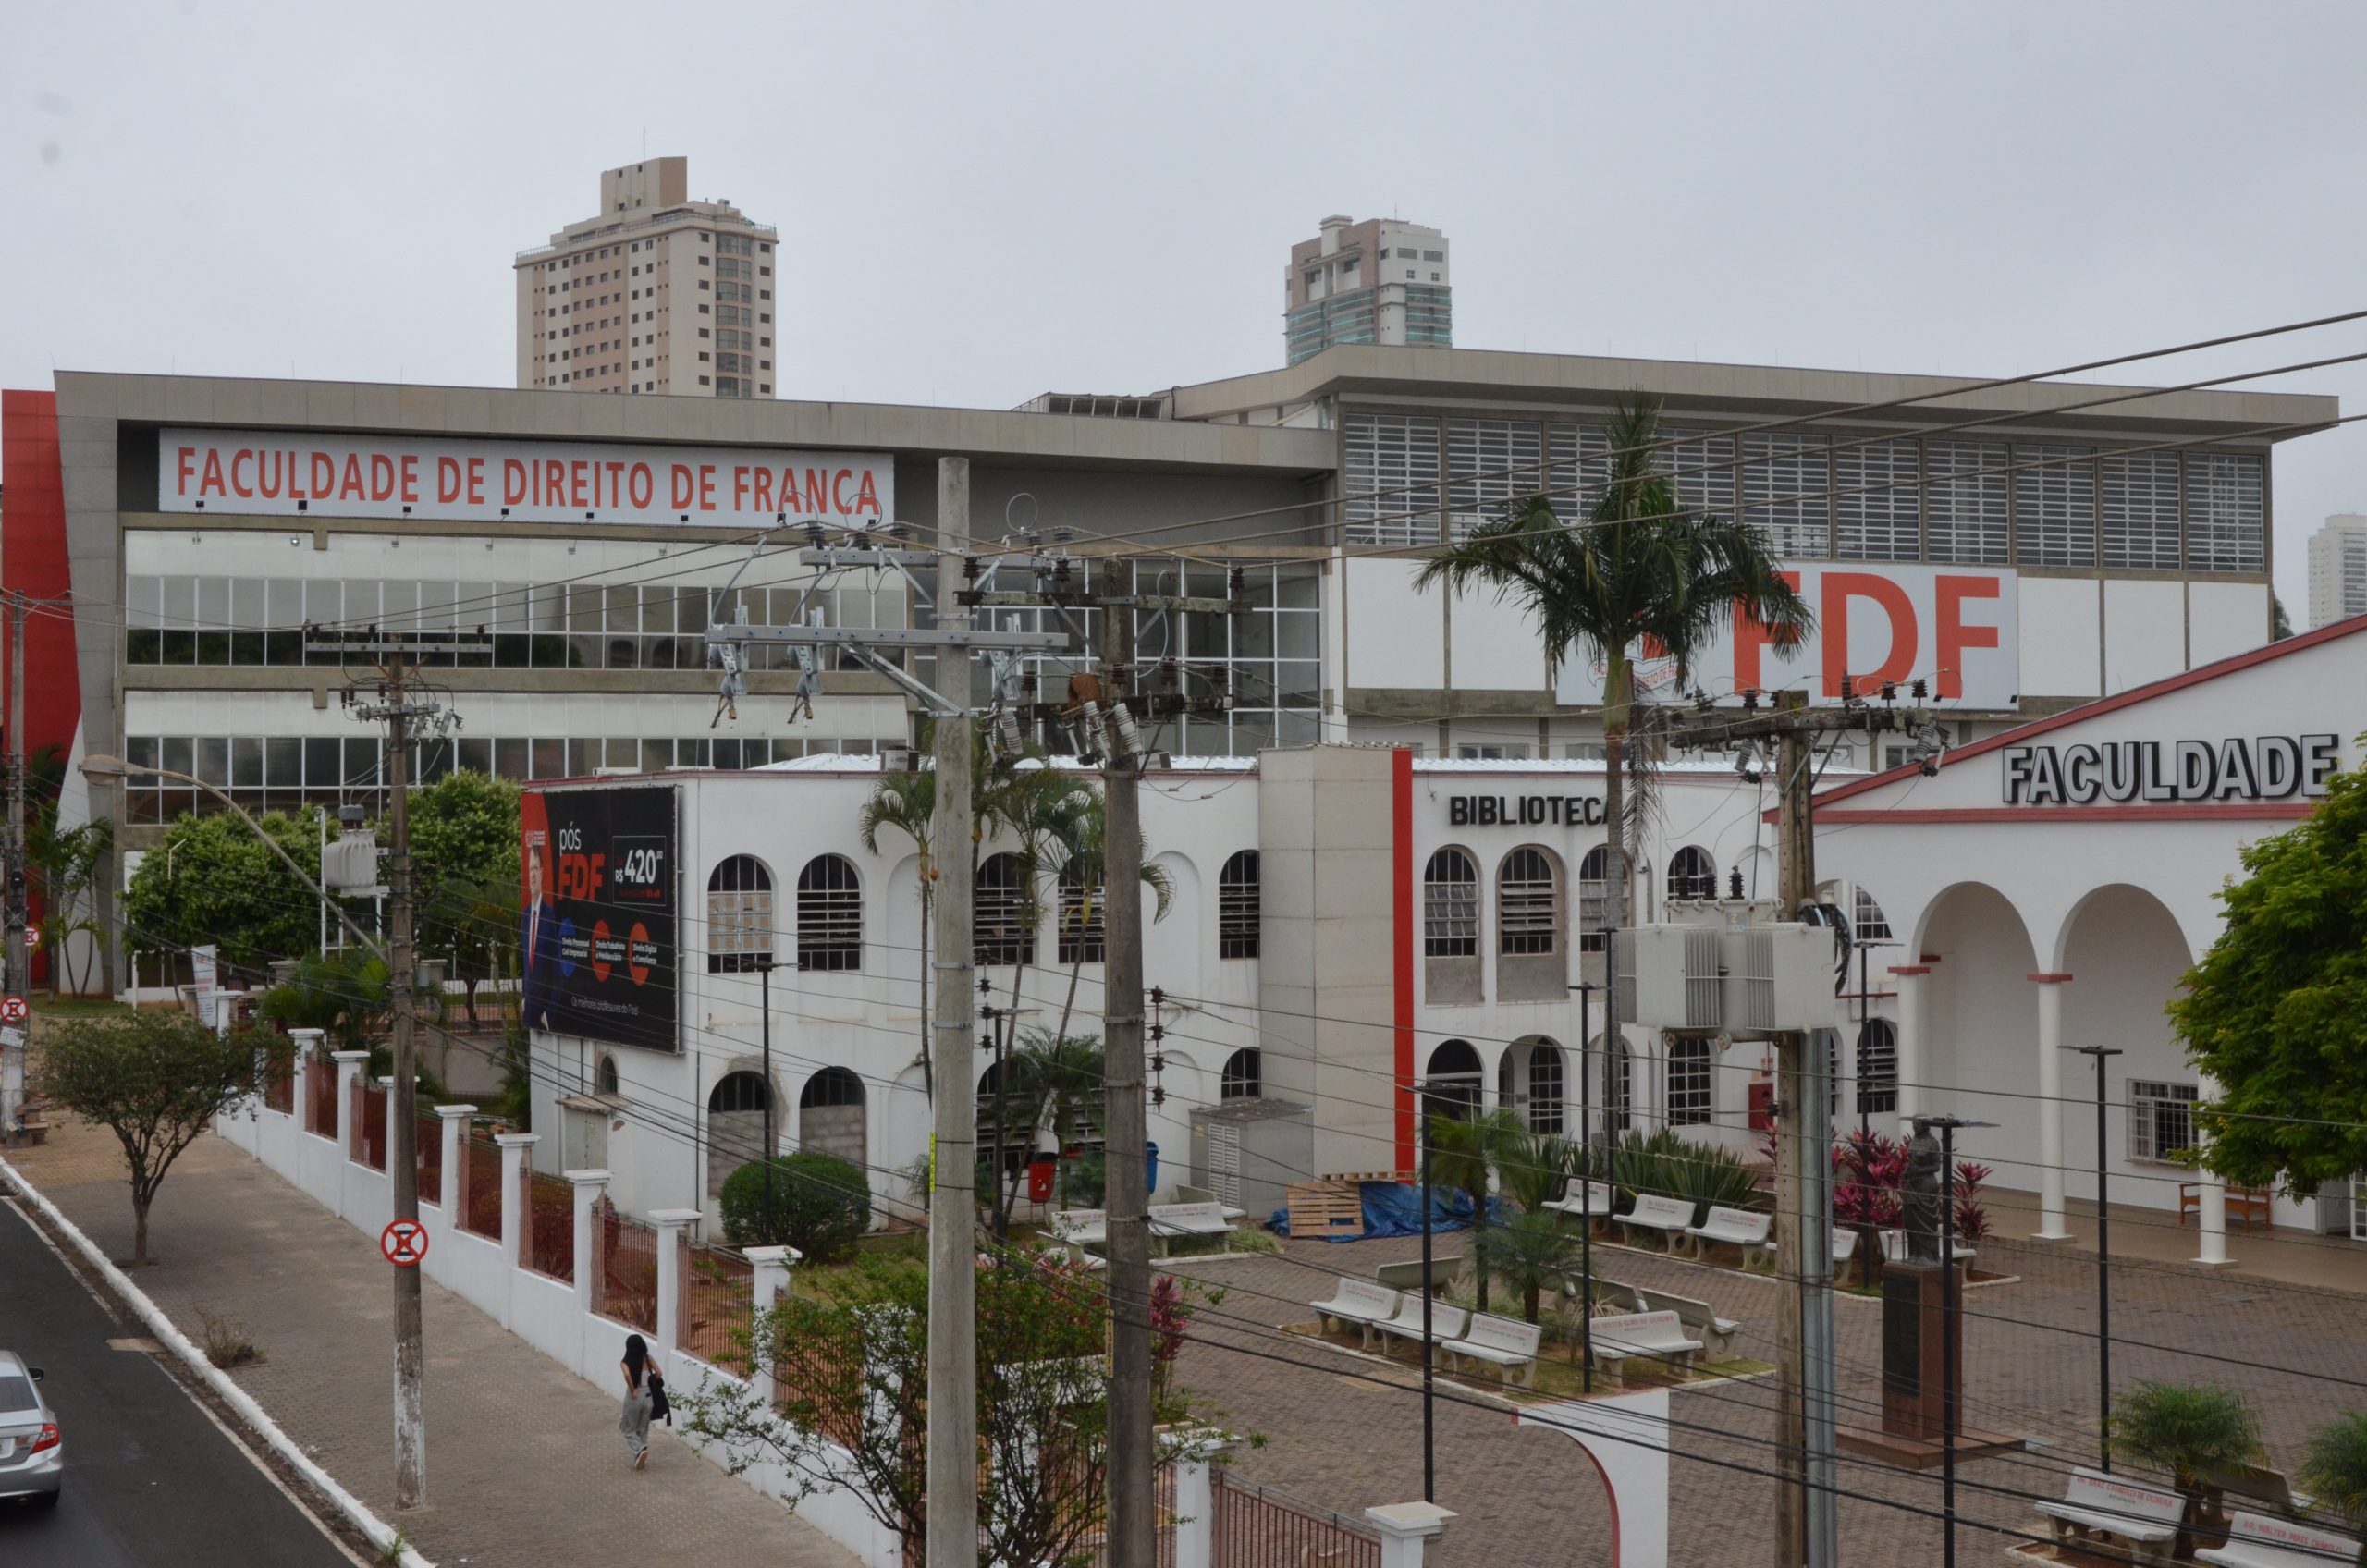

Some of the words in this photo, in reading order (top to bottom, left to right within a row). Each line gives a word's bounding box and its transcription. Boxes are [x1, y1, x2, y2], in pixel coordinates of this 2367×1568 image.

[178, 447, 419, 503] FACULDADE
[438, 458, 484, 504] DE
[504, 459, 653, 508] DIREITO
[672, 465, 716, 510] DE
[734, 466, 879, 515] FRANCA
[1735, 570, 2000, 698] FDF
[2003, 734, 2339, 802] FACULDADE
[559, 821, 581, 857] pós
[1450, 795, 1608, 826] BIBLIOTEC
[558, 853, 606, 901] FDF
